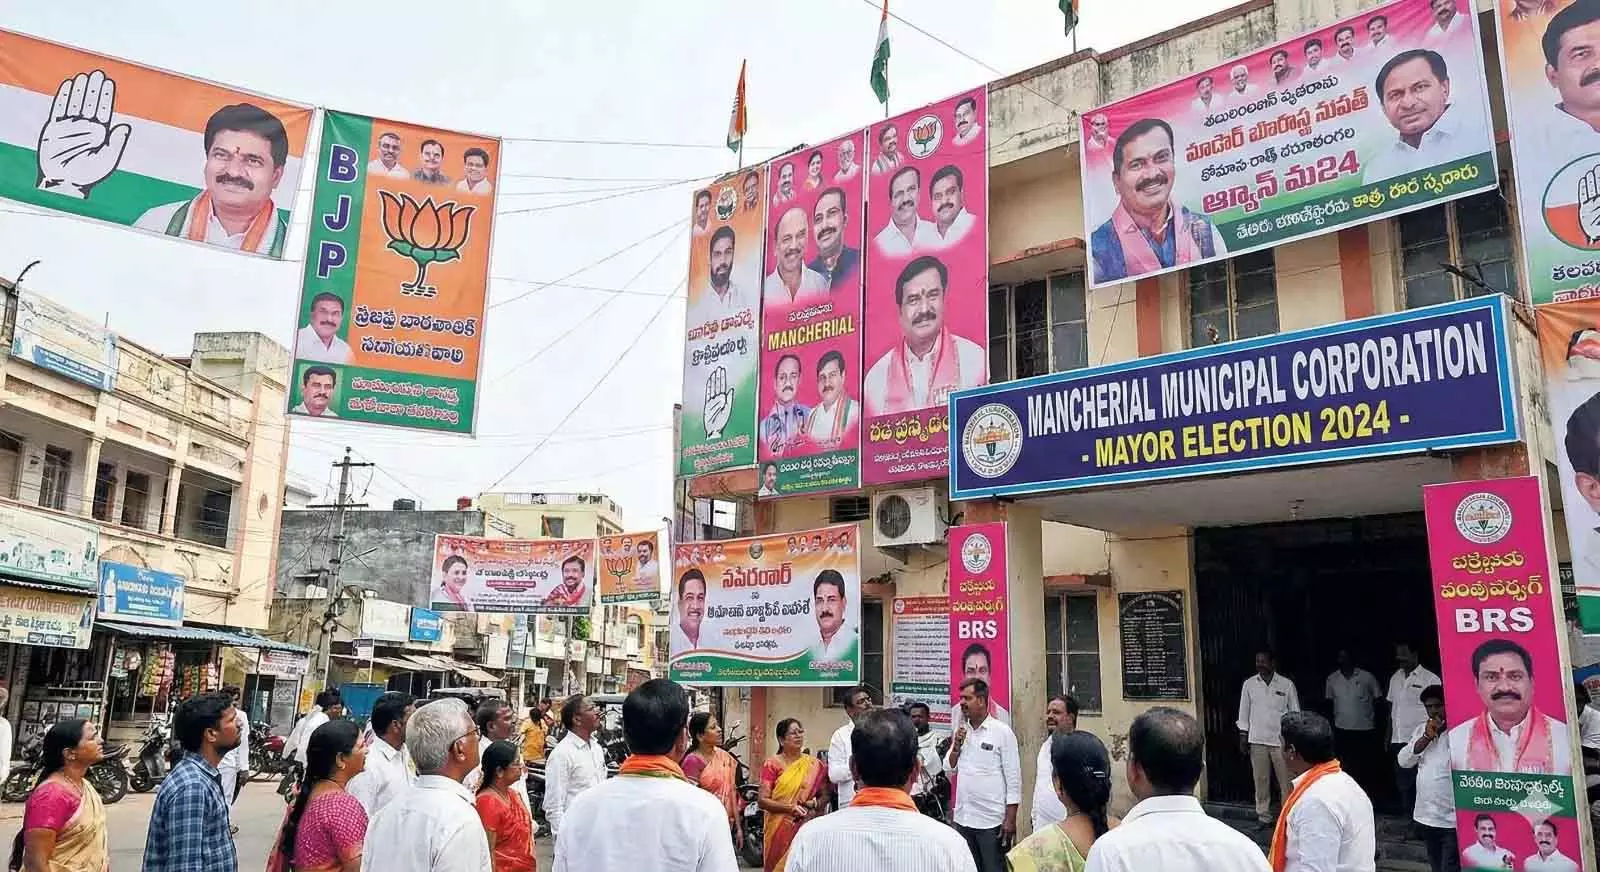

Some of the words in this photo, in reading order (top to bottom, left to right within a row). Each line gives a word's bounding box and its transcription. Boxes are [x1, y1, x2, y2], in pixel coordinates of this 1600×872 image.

[316, 144, 359, 279] BJP
[1027, 377, 1155, 438] MANCHERIAL
[1160, 355, 1286, 419] MUNICIPAL
[1292, 321, 1487, 400] CORPORATION
[1095, 429, 1177, 467] MAYOR
[1183, 411, 1312, 458] ELECTION
[1320, 400, 1390, 442] 2024
[958, 620, 998, 639] BRS
[1455, 607, 1534, 633] BRS
